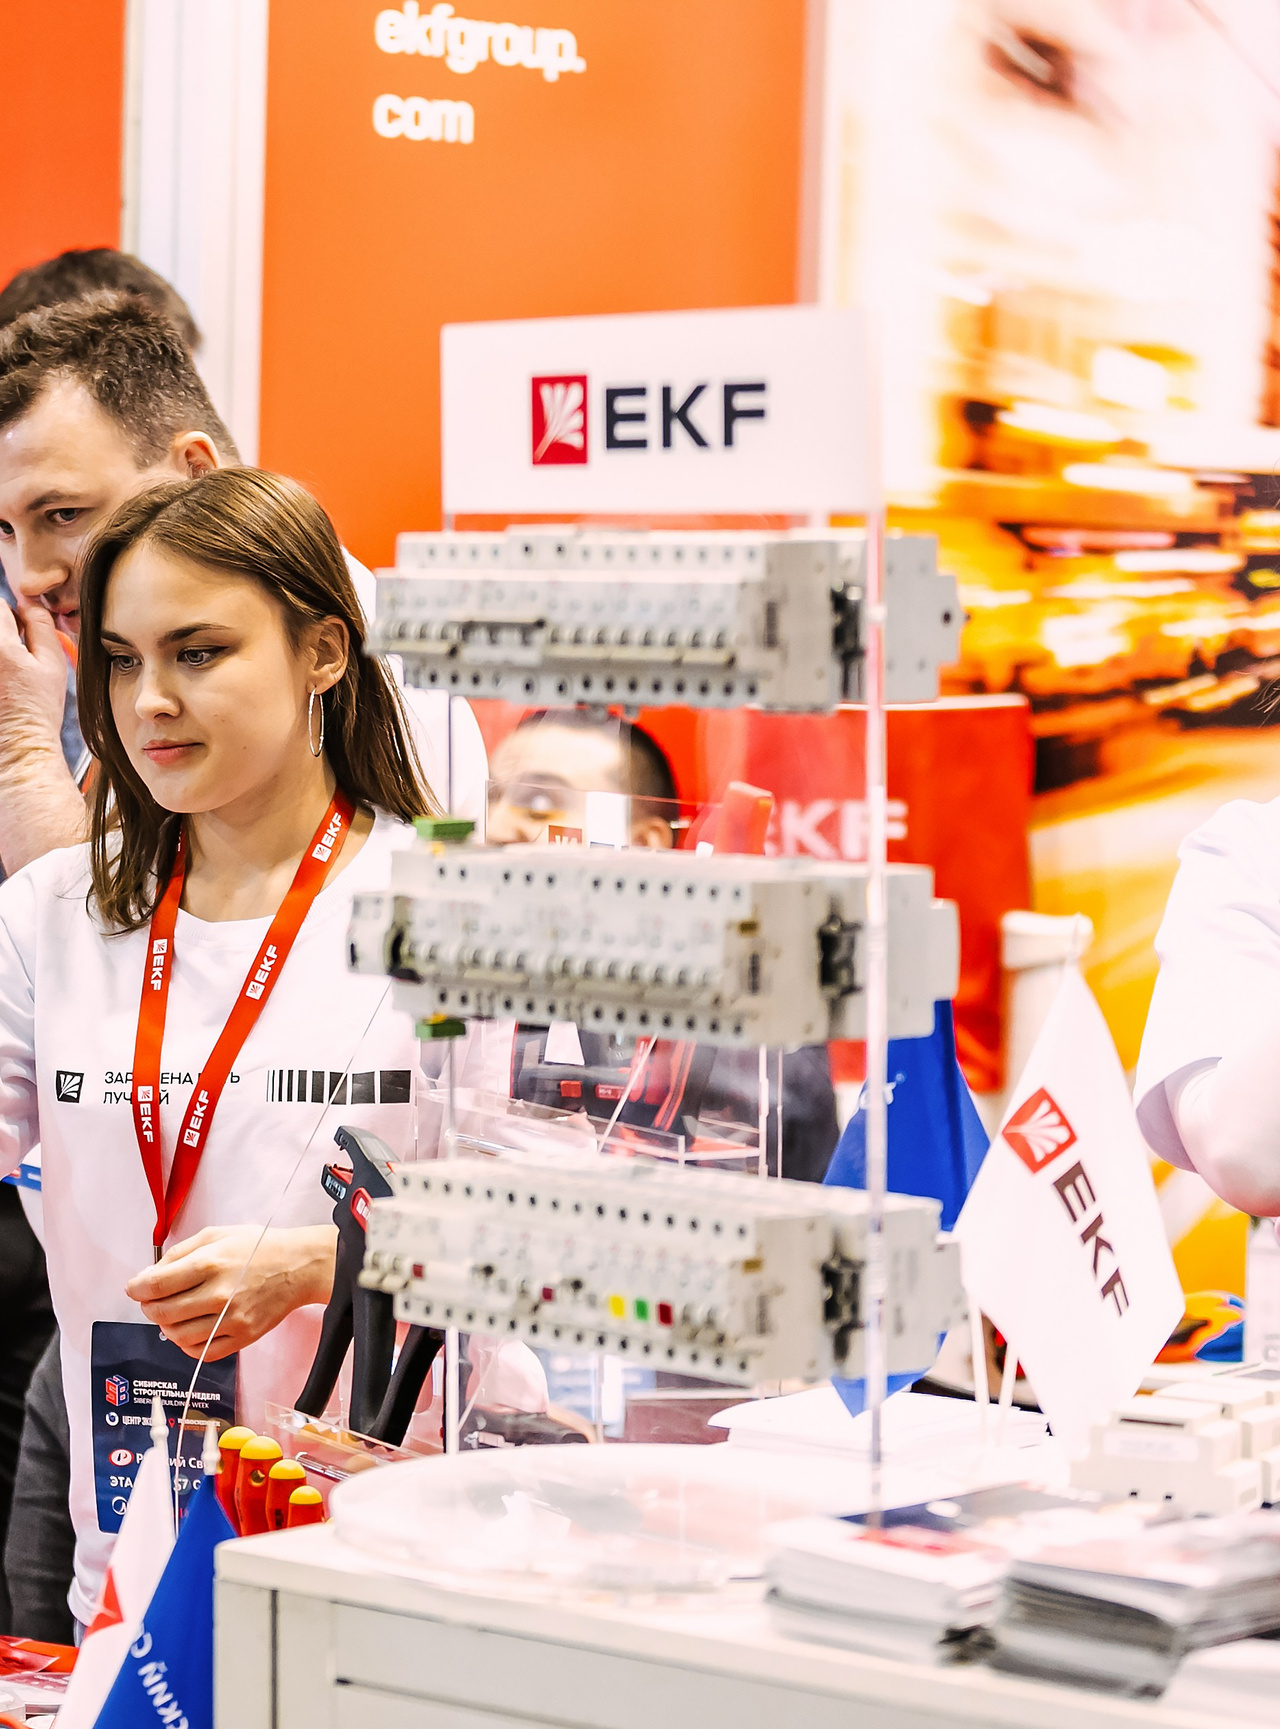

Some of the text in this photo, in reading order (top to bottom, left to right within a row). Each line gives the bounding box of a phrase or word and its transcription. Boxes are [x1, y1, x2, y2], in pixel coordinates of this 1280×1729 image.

[375, 0, 584, 82] ekfgroup.
[373, 94, 475, 144] com
[606, 383, 766, 449] EKF
[321, 812, 342, 848] EKF
[765, 800, 908, 860] KF
[150, 955, 165, 991] EKF
[254, 944, 278, 983] EKF
[104, 1071, 194, 1085] ЗАРЕНА
[103, 1089, 170, 1105] ЛУЧЙ
[189, 1089, 209, 1130] EKF
[139, 1103, 154, 1143] EKF
[1053, 1161, 1129, 1317] EKF
[132, 1379, 178, 1390] СИБИРСКАЯ
[132, 1388, 221, 1401] СТРОИТЕЛЬНАЯ НЕДЕЛЯ
[122, 1415, 142, 1426] ЦЕНТР
[191, 1401, 210, 1409] WEEK
